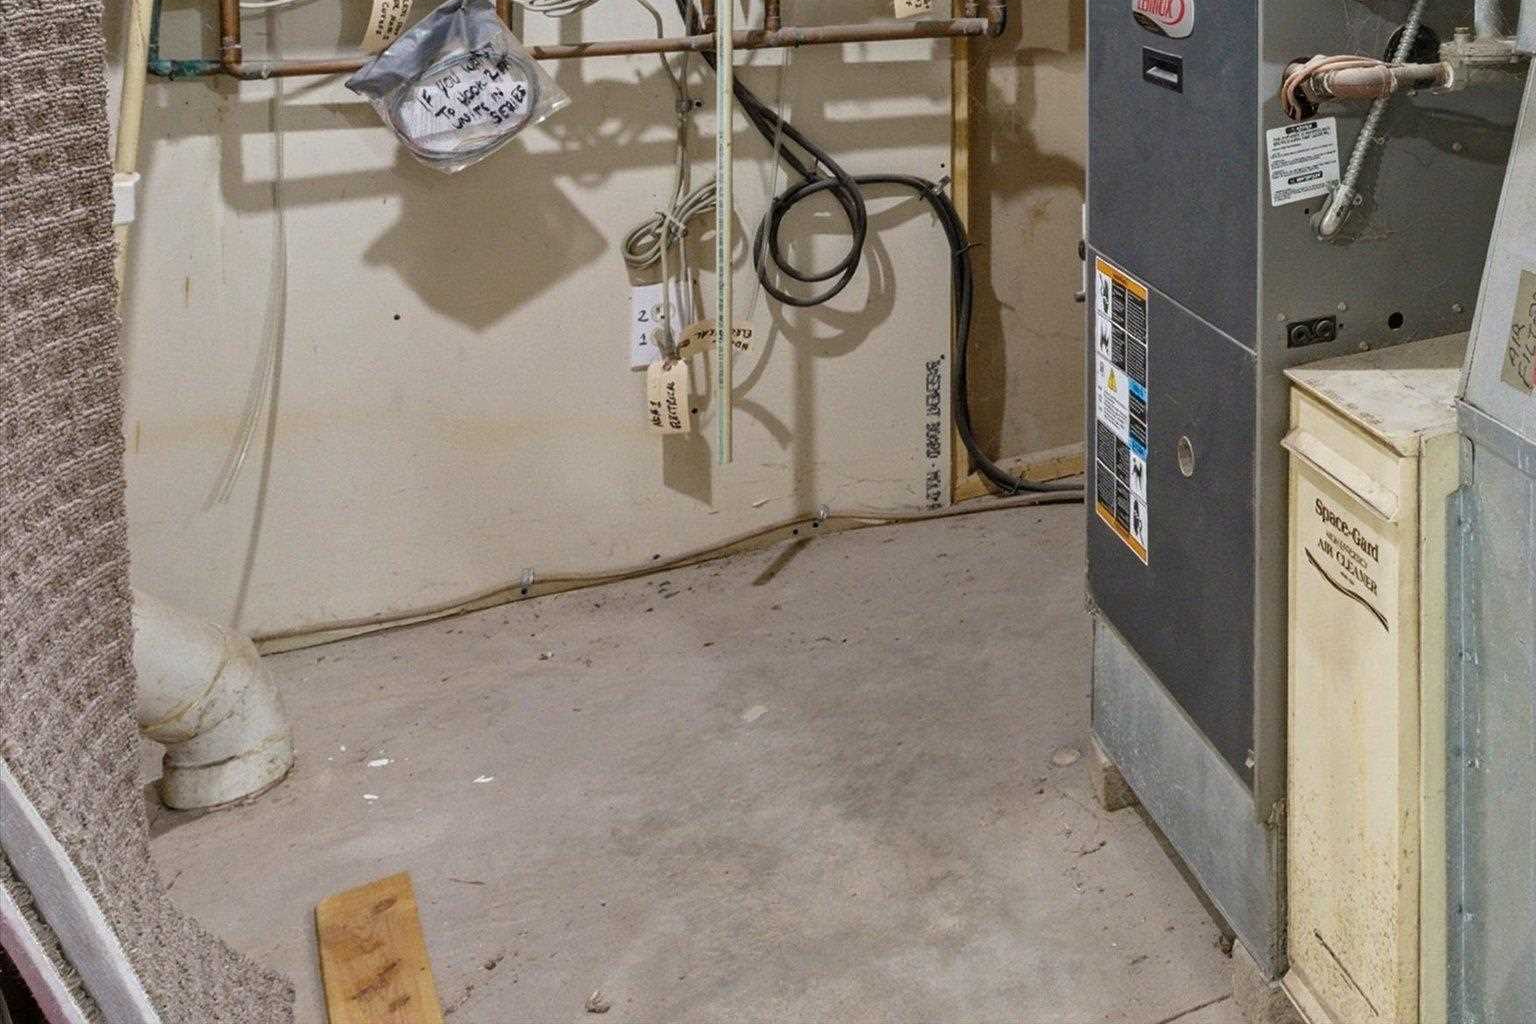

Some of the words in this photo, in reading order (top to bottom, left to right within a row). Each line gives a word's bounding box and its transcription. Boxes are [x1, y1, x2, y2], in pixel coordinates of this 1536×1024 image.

[435, 69, 461, 100] YOU
[435, 105, 456, 122] TO
[637, 310, 649, 322] 2
[639, 333, 647, 345] 1
[1508, 324, 1525, 366] AIR
[1318, 538, 1334, 559] AIR
[1336, 550, 1378, 597] CLEANER
